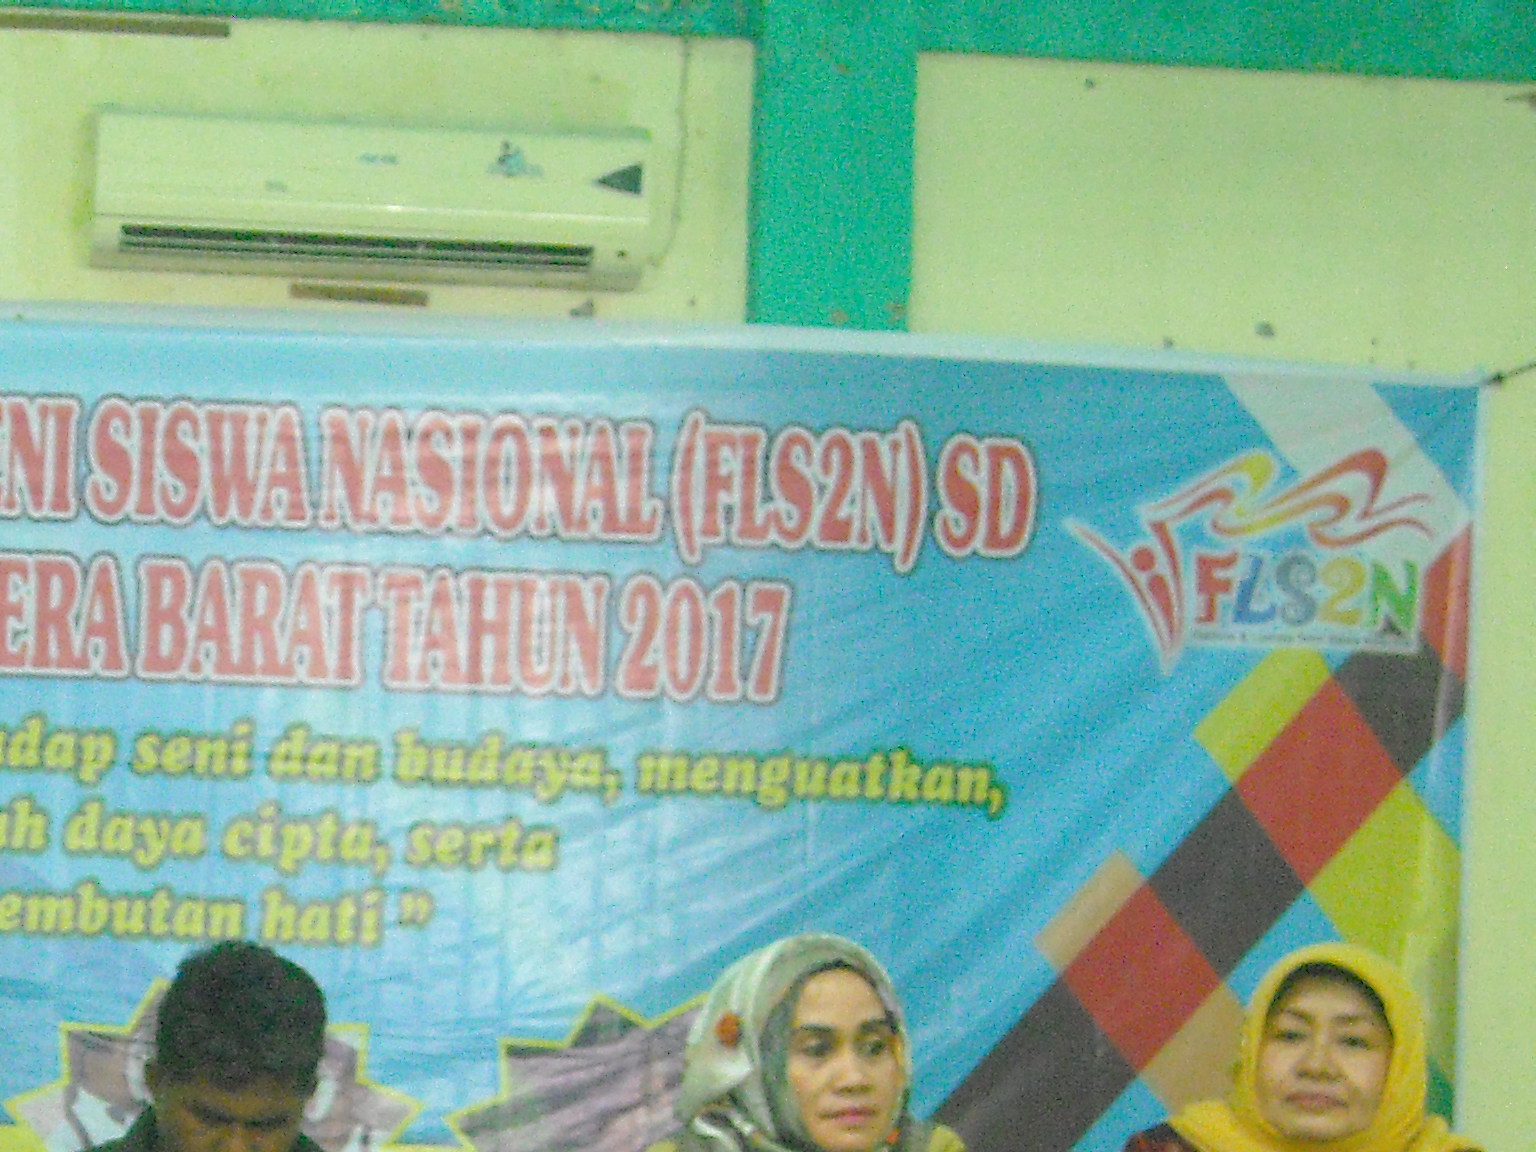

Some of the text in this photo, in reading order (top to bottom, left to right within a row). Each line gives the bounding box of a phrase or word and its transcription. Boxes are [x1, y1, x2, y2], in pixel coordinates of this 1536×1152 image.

[86, 396, 311, 527] SISWA
[320, 408, 663, 542] NASIONAL
[671, 411, 926, 572] (FLS2N)
[934, 434, 1036, 557] SD
[138, 556, 364, 687] BARAT
[381, 564, 609, 694] TAHUN
[616, 575, 792, 700] 2017
[1195, 552, 1419, 630] FLS2N
[132, 719, 254, 776] seni
[269, 723, 379, 780] dan
[394, 730, 620, 802] budaya,
[638, 748, 1002, 817] menguatkan,
[66, 801, 205, 866] daya
[223, 803, 389, 875] cipta,
[406, 818, 557, 868] serta
[261, 887, 384, 944] hati
